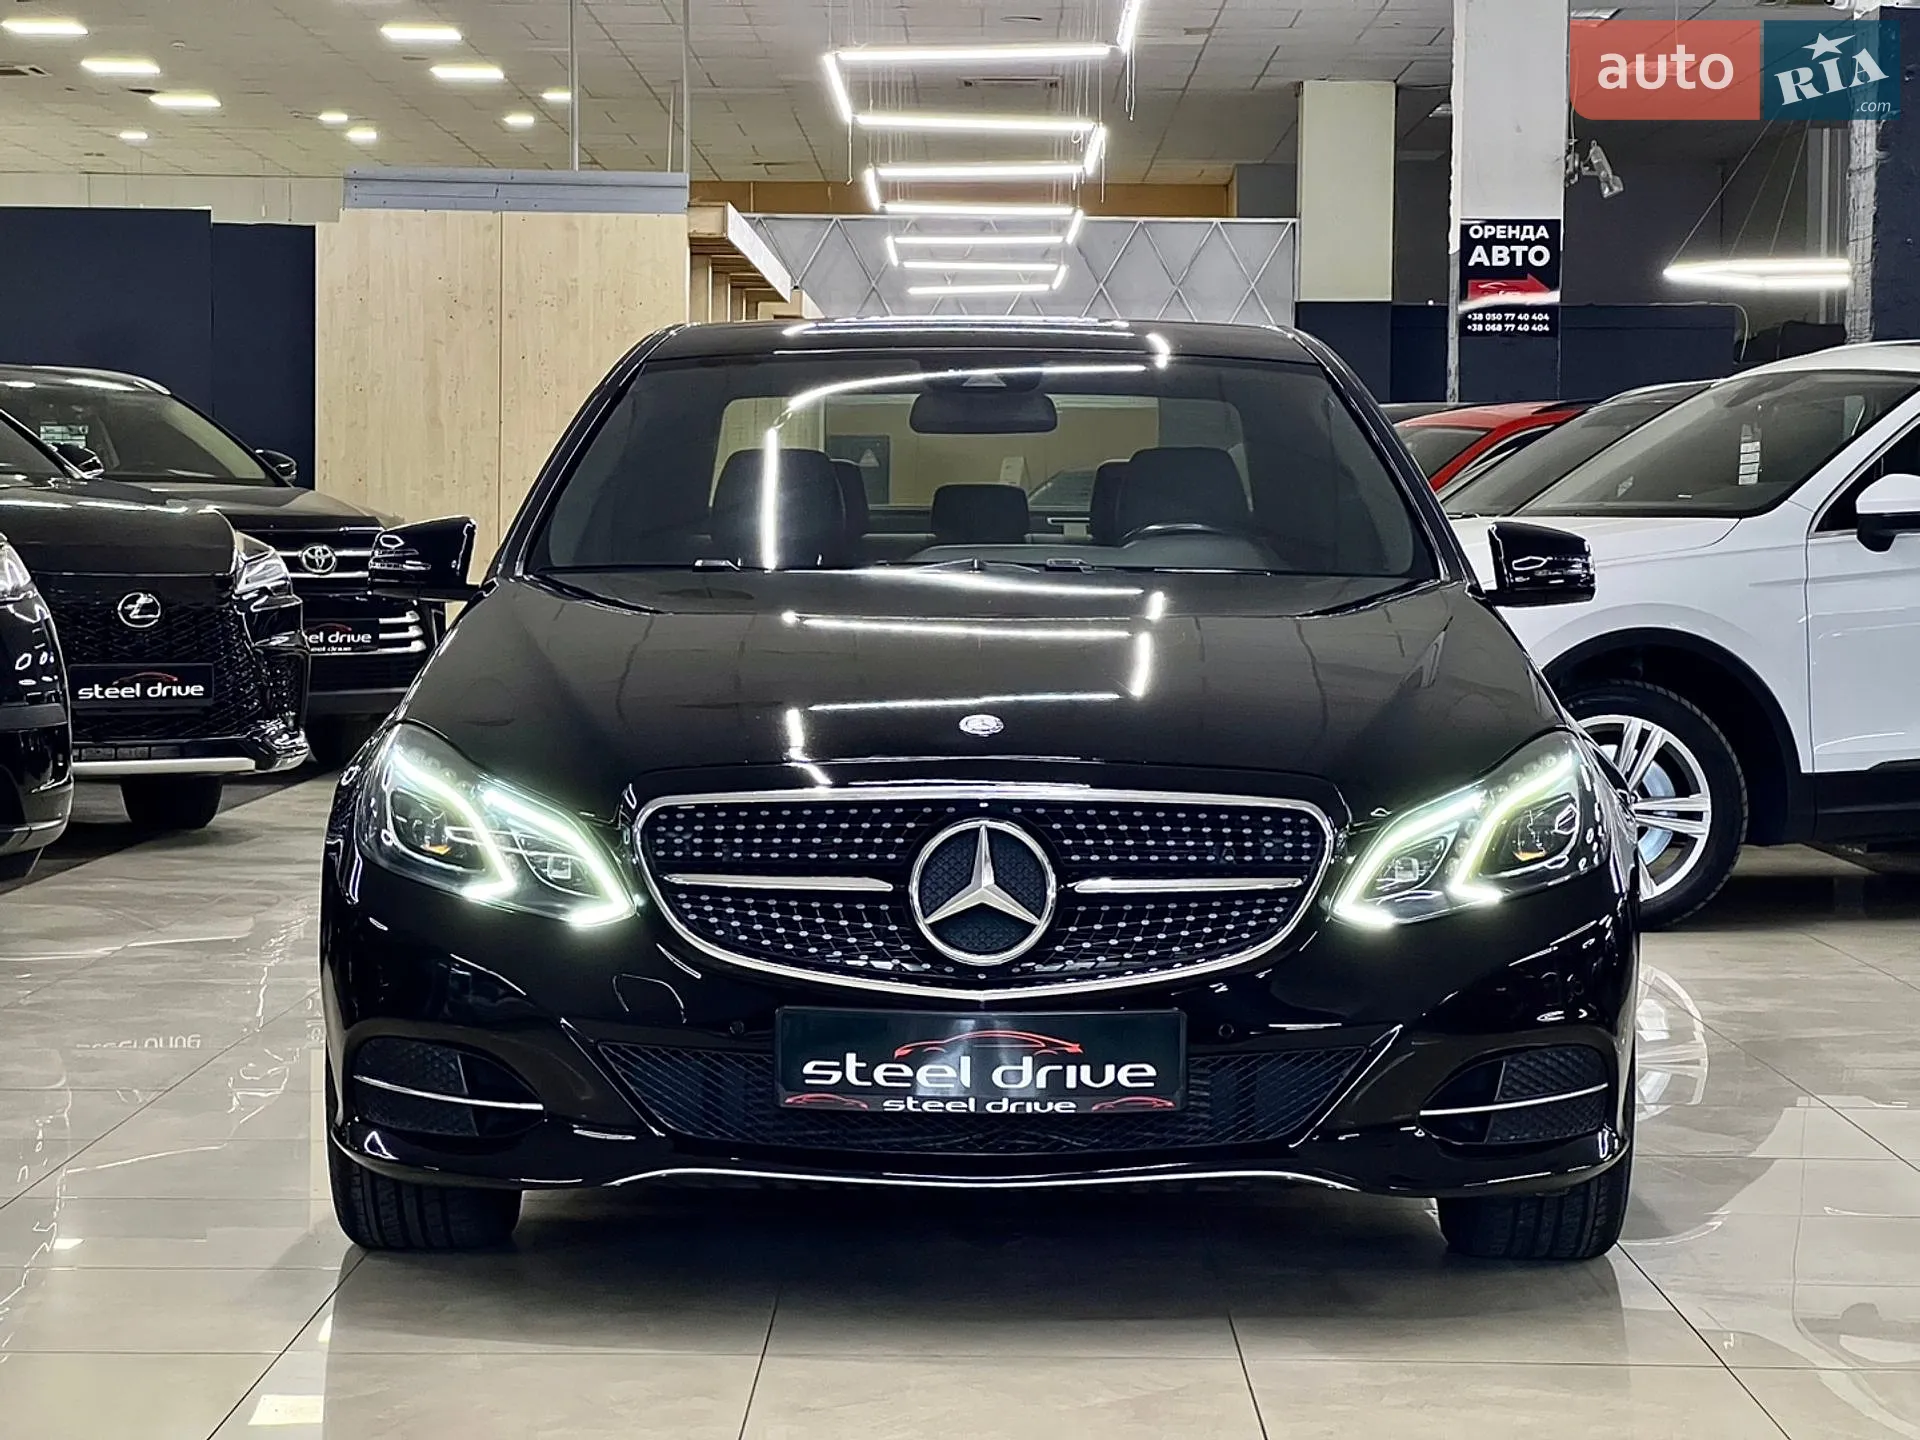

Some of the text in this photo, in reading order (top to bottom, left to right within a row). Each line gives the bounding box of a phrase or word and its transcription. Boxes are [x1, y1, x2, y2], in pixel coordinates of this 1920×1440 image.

[1468, 225, 1549, 241] ОРЕНДА
[1467, 245, 1551, 267] АВТО
[1504, 312, 1516, 321] 77
[1517, 312, 1530, 321] 40
[1531, 312, 1549, 321] 404
[1504, 323, 1516, 332] 77
[1517, 323, 1530, 332] 40
[1531, 323, 1549, 332] 404
[327, 631, 372, 643] drive
[78, 682, 205, 699] steel drive
[802, 1052, 1157, 1089] steel drive
[882, 1096, 1077, 1114] steel drive
